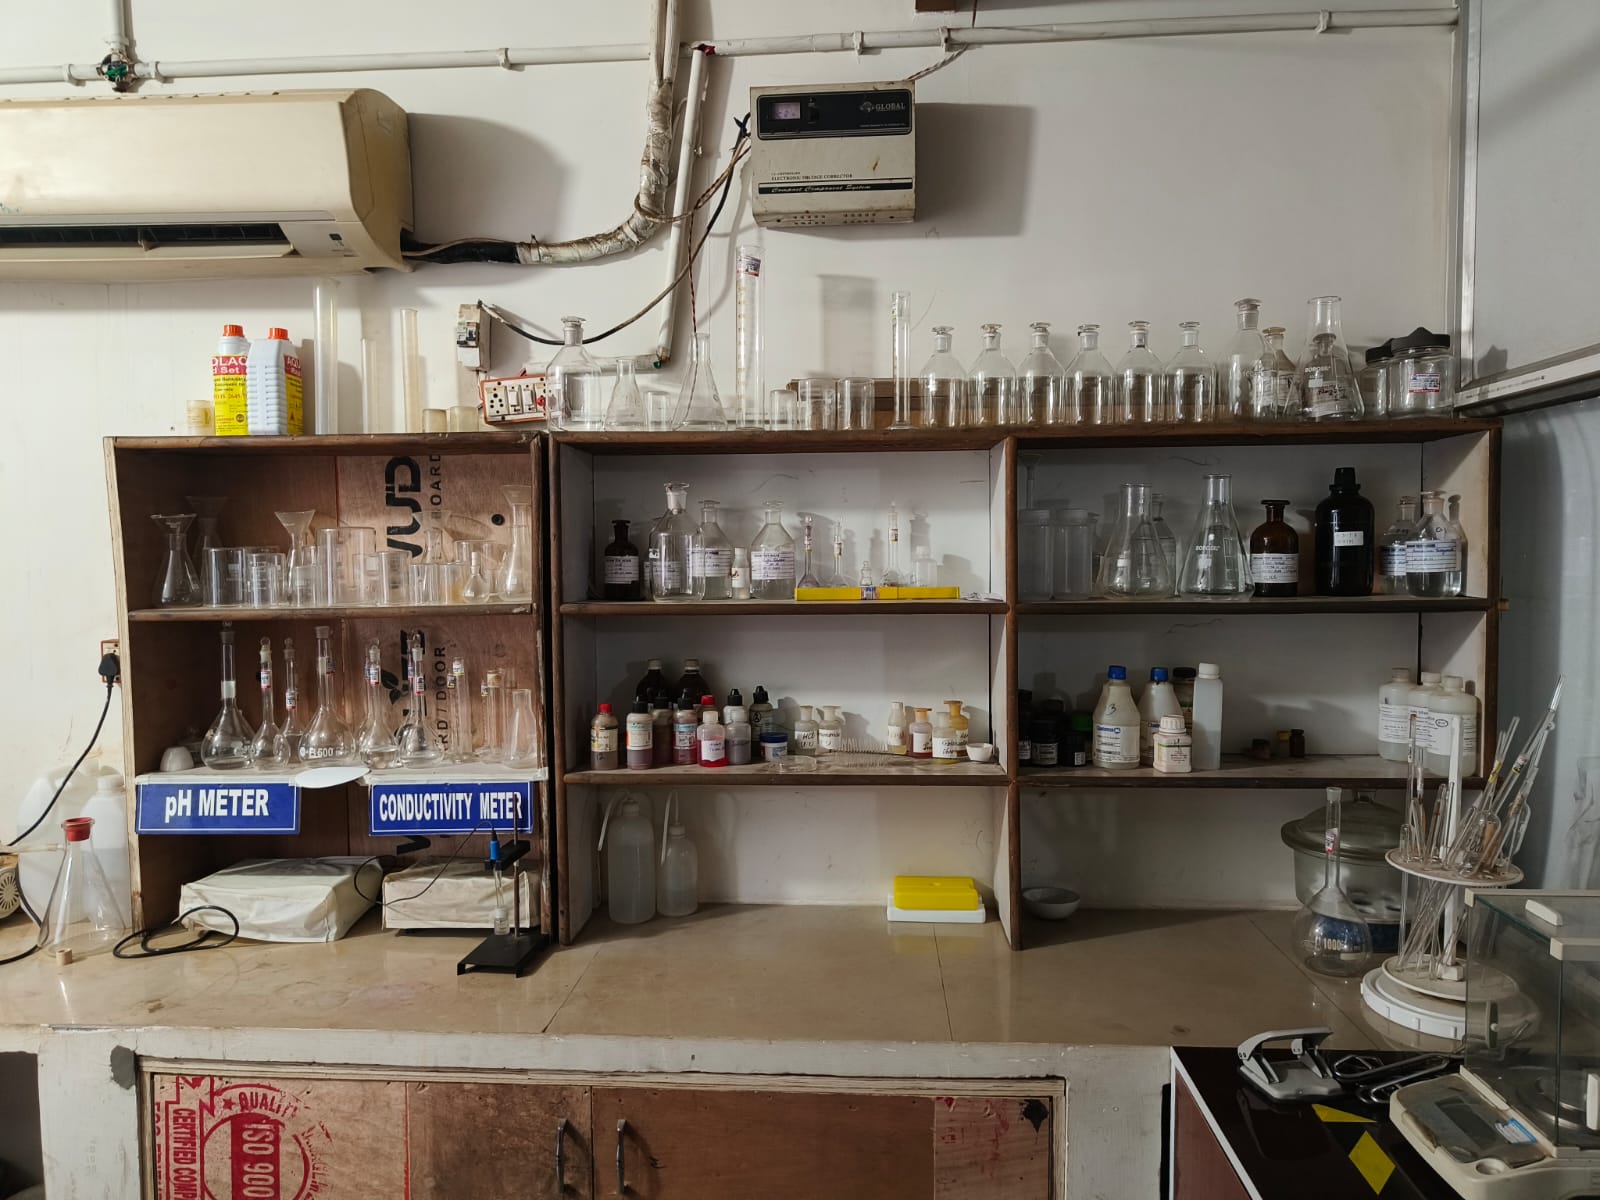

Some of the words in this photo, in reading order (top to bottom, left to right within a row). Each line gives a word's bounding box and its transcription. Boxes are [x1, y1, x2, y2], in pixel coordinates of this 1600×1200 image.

[875, 102, 906, 111] GLOBAL
[317, 747, 334, 757] 500
[164, 789, 192, 824] pH
[198, 789, 269, 817] METER
[379, 792, 473, 822] CONDUCTIVITY
[479, 791, 523, 820] METER
[172, 1108, 197, 1165] CERTIFIED
[242, 1123, 275, 1156] ISO
[173, 1167, 198, 1200] COMP
